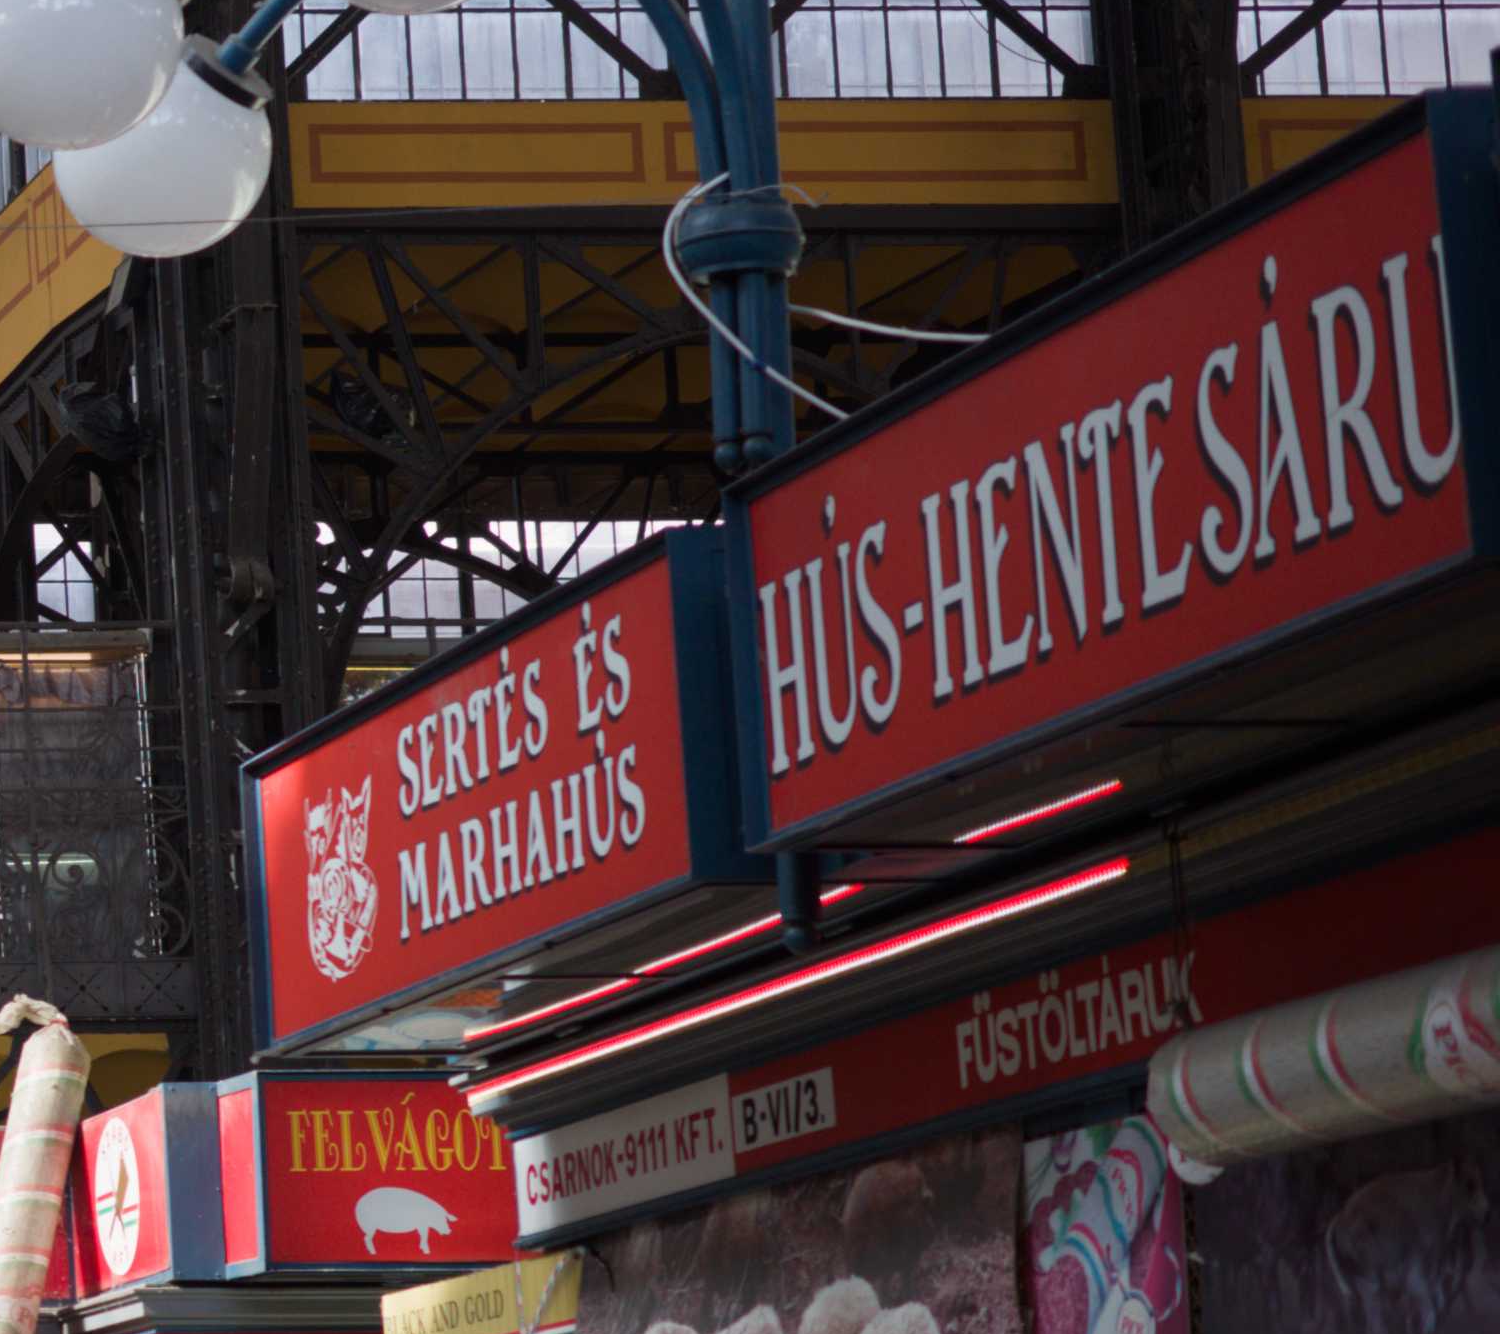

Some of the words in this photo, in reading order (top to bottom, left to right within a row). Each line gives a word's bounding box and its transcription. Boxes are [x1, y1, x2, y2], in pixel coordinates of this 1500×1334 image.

[758, 233, 1463, 779] HÚS-HENTESÁRU
[396, 639, 550, 820] SERTÉS
[574, 599, 634, 723] ÉS
[396, 729, 649, 943] MARHAHÚS
[955, 949, 1204, 1091] FÜSTÖLTÁRUK
[286, 1091, 508, 1173] FELVÁGOT
[525, 1117, 671, 1208] CSARNOK-9111
[673, 1107, 724, 1172] KFT.
[742, 1078, 827, 1147] B-VI/3.
[463, 1288, 505, 1326] GOLD
